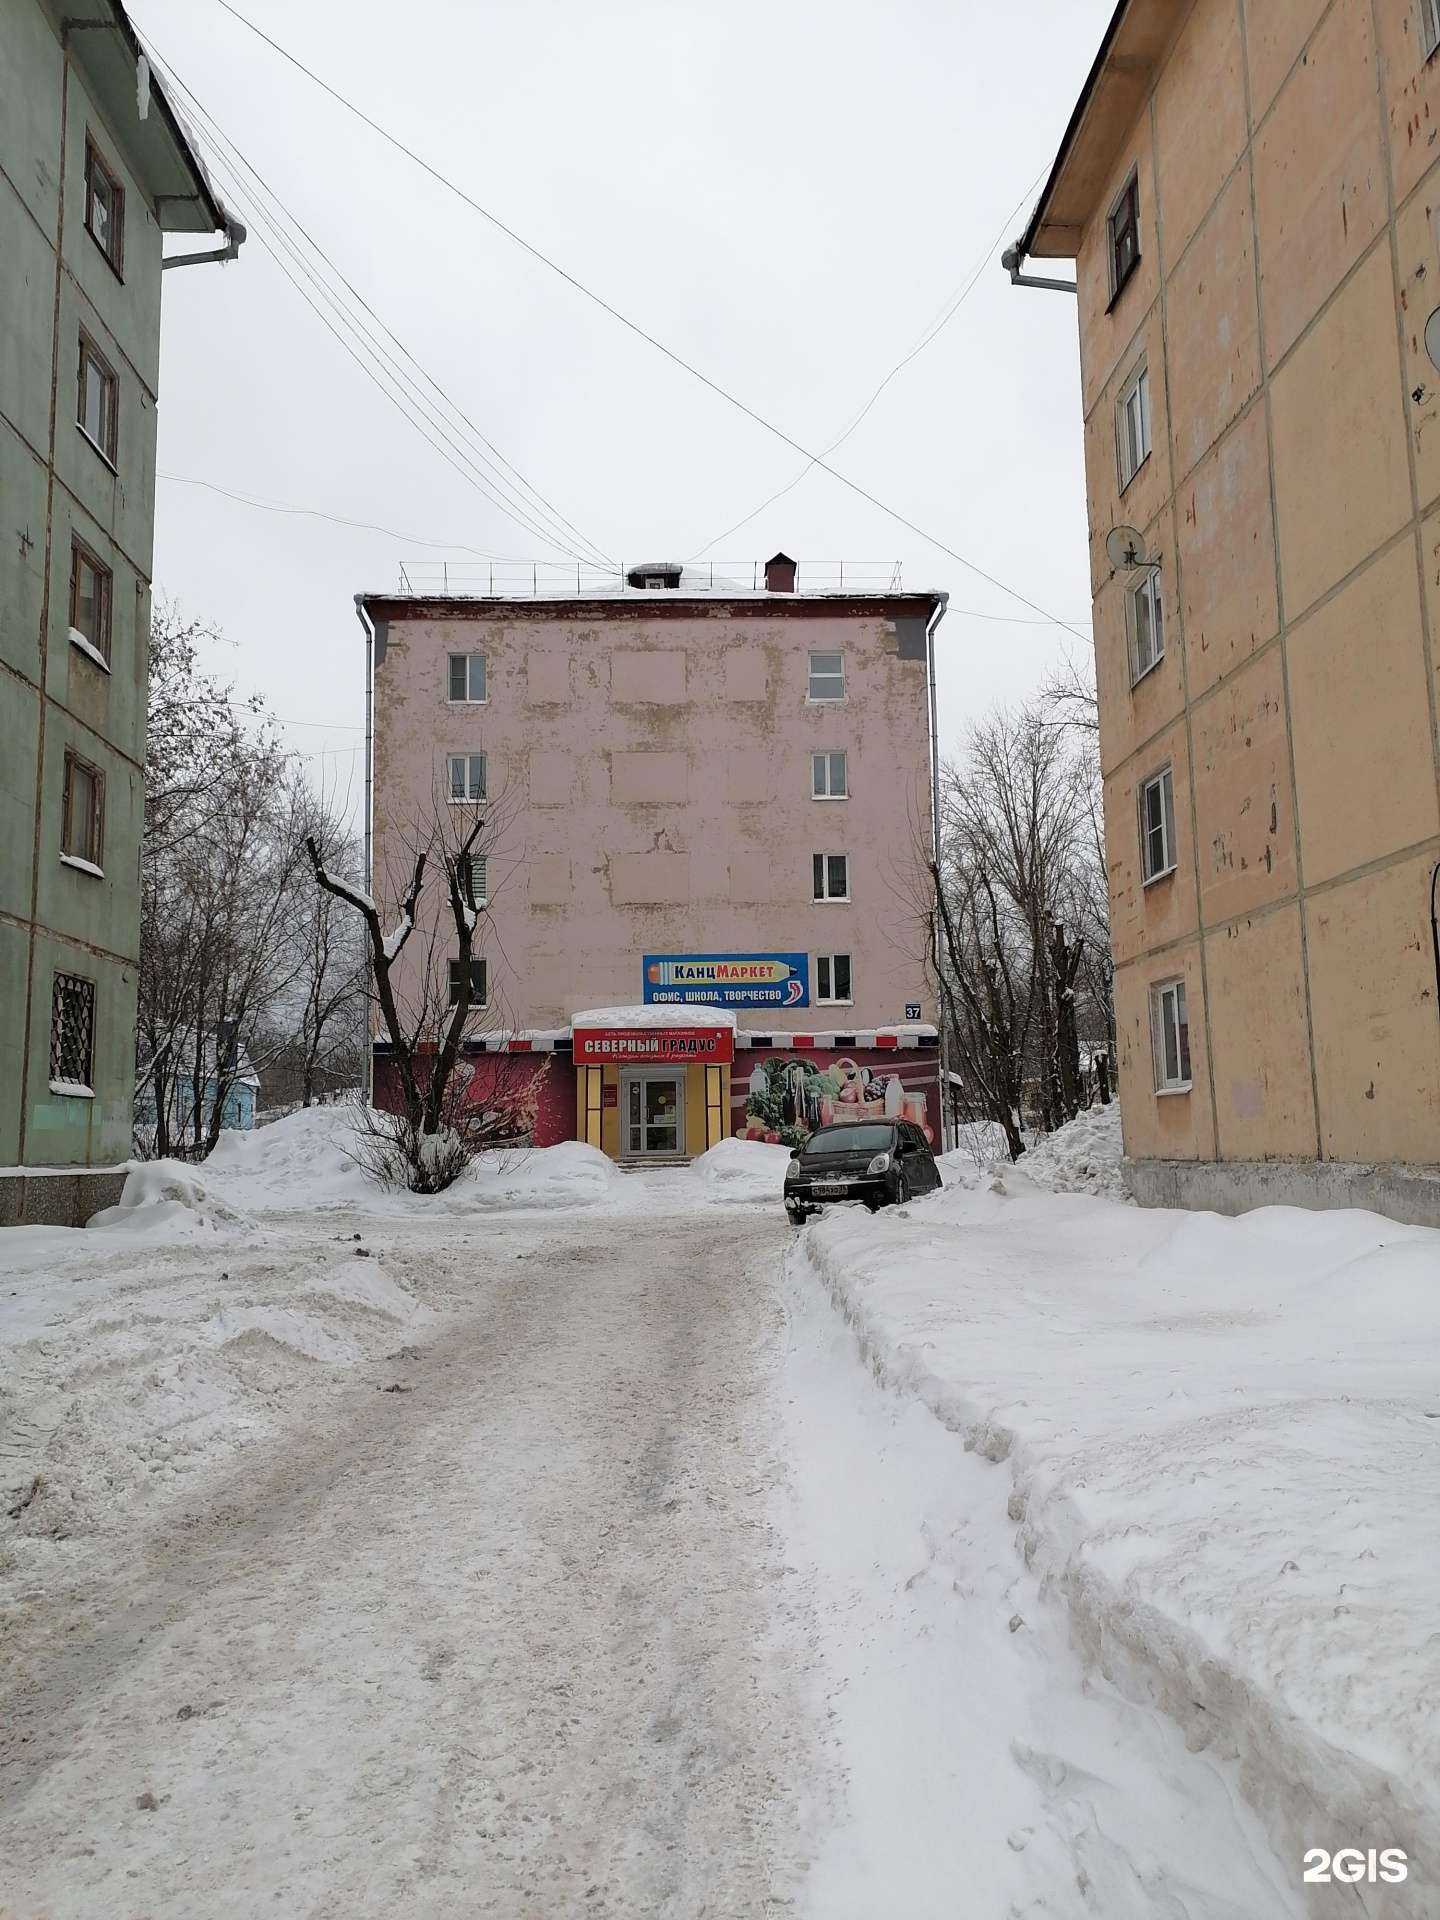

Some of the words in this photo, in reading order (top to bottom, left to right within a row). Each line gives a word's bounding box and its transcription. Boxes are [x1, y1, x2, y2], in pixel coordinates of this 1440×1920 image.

[652, 990, 683, 1002] ОФИС,
[685, 990, 722, 1002] ШКОЛА,
[724, 990, 782, 1001] ТВОРЧЕСТВО
[906, 1007, 920, 1018] 37
[584, 1037, 659, 1053] СЕВЕРНЫЙ
[661, 1038, 717, 1053] ГРАДУС
